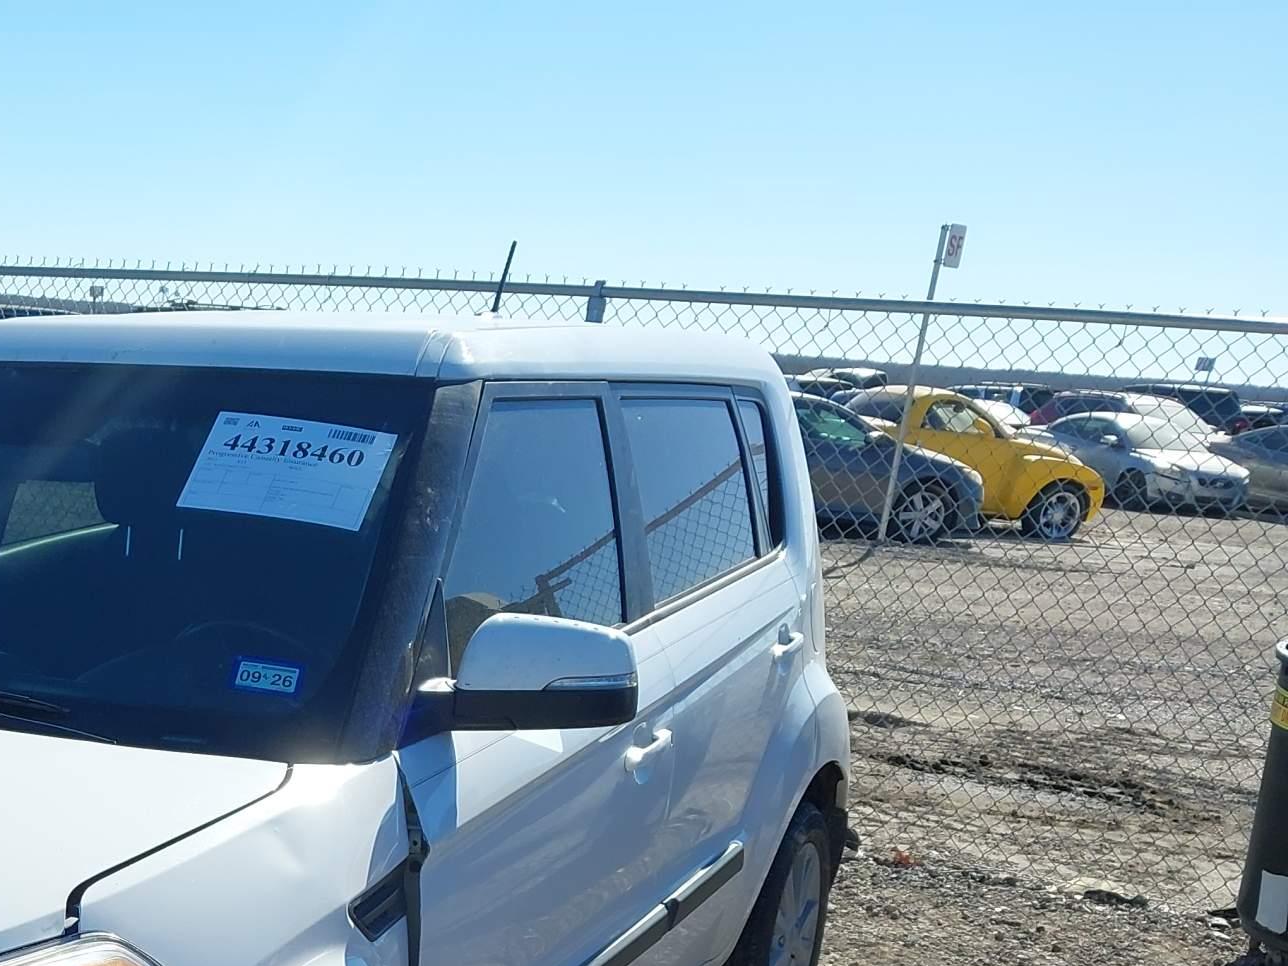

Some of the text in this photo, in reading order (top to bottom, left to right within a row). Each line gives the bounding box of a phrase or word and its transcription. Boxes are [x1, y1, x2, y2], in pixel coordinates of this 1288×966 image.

[223, 433, 365, 467] 44318460
[240, 670, 293, 687] 09 26
